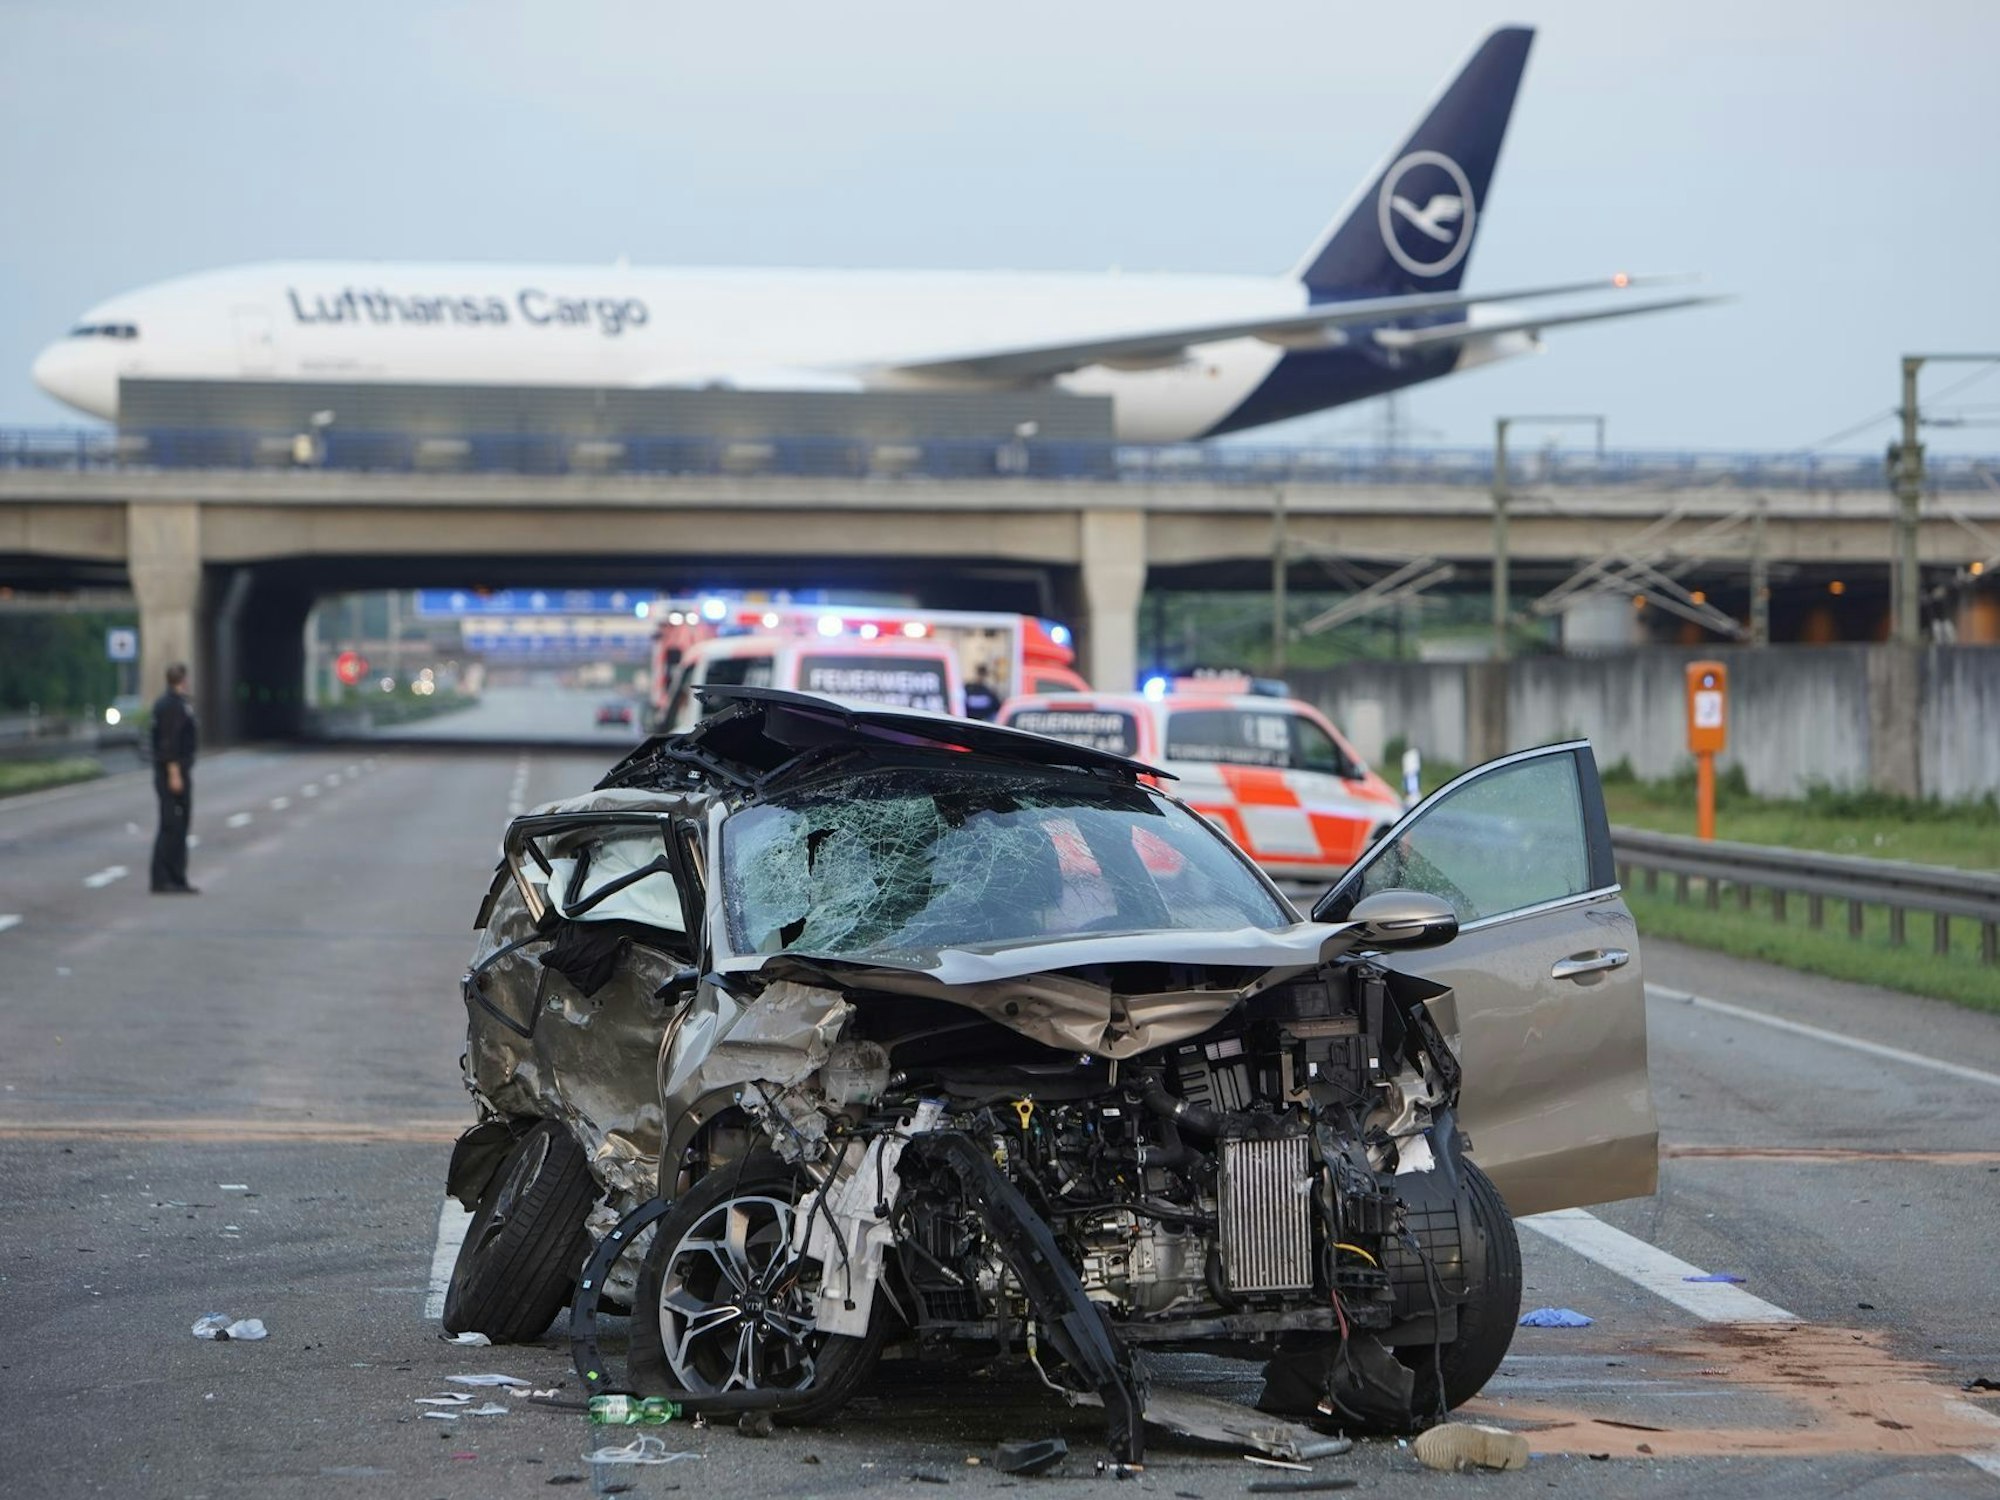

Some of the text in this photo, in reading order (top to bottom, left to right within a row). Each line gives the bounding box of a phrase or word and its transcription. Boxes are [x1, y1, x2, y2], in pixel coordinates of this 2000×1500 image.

[288, 286, 649, 336] Lufthansa Cargo
[809, 667, 940, 693] FEUERWEHR
[1015, 711, 1124, 734] FEUERWEHR
